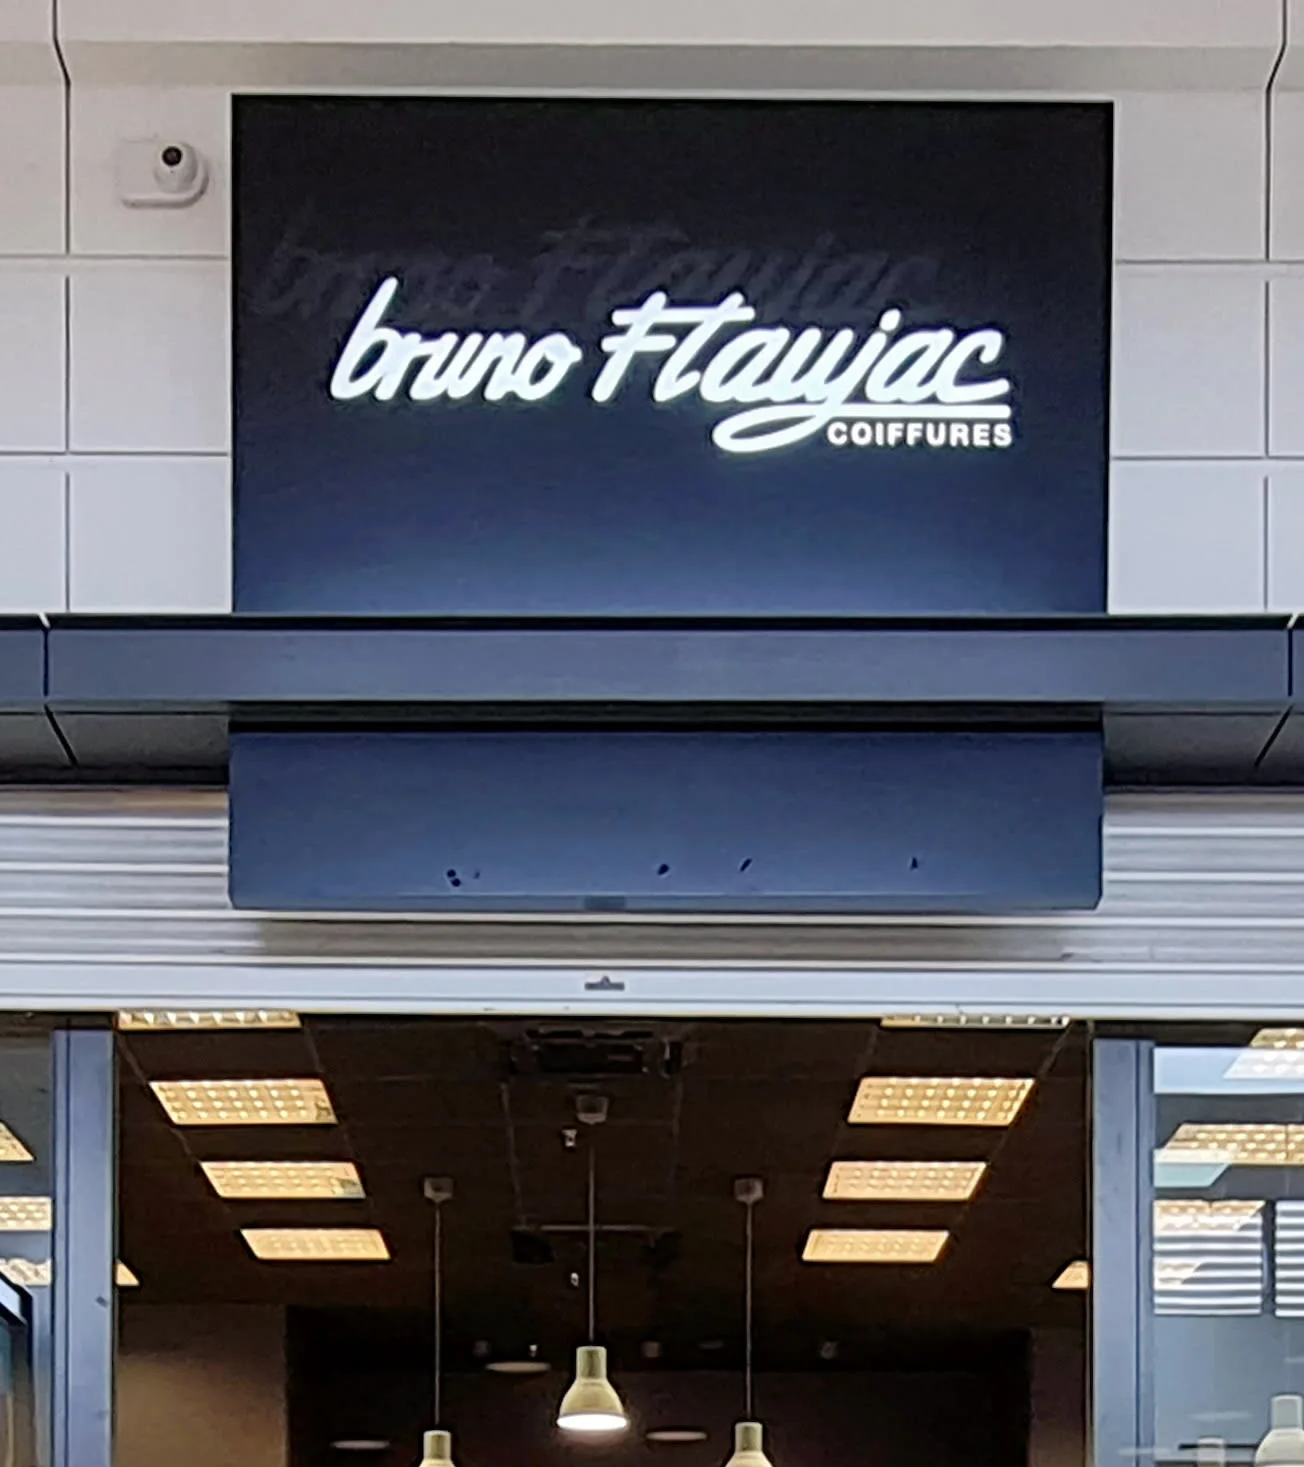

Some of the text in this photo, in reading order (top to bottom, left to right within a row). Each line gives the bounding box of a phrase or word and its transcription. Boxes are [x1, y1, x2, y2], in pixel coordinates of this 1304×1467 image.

[330, 277, 1012, 453] bruno Flaujac
[826, 421, 1013, 447] COIFFURES
